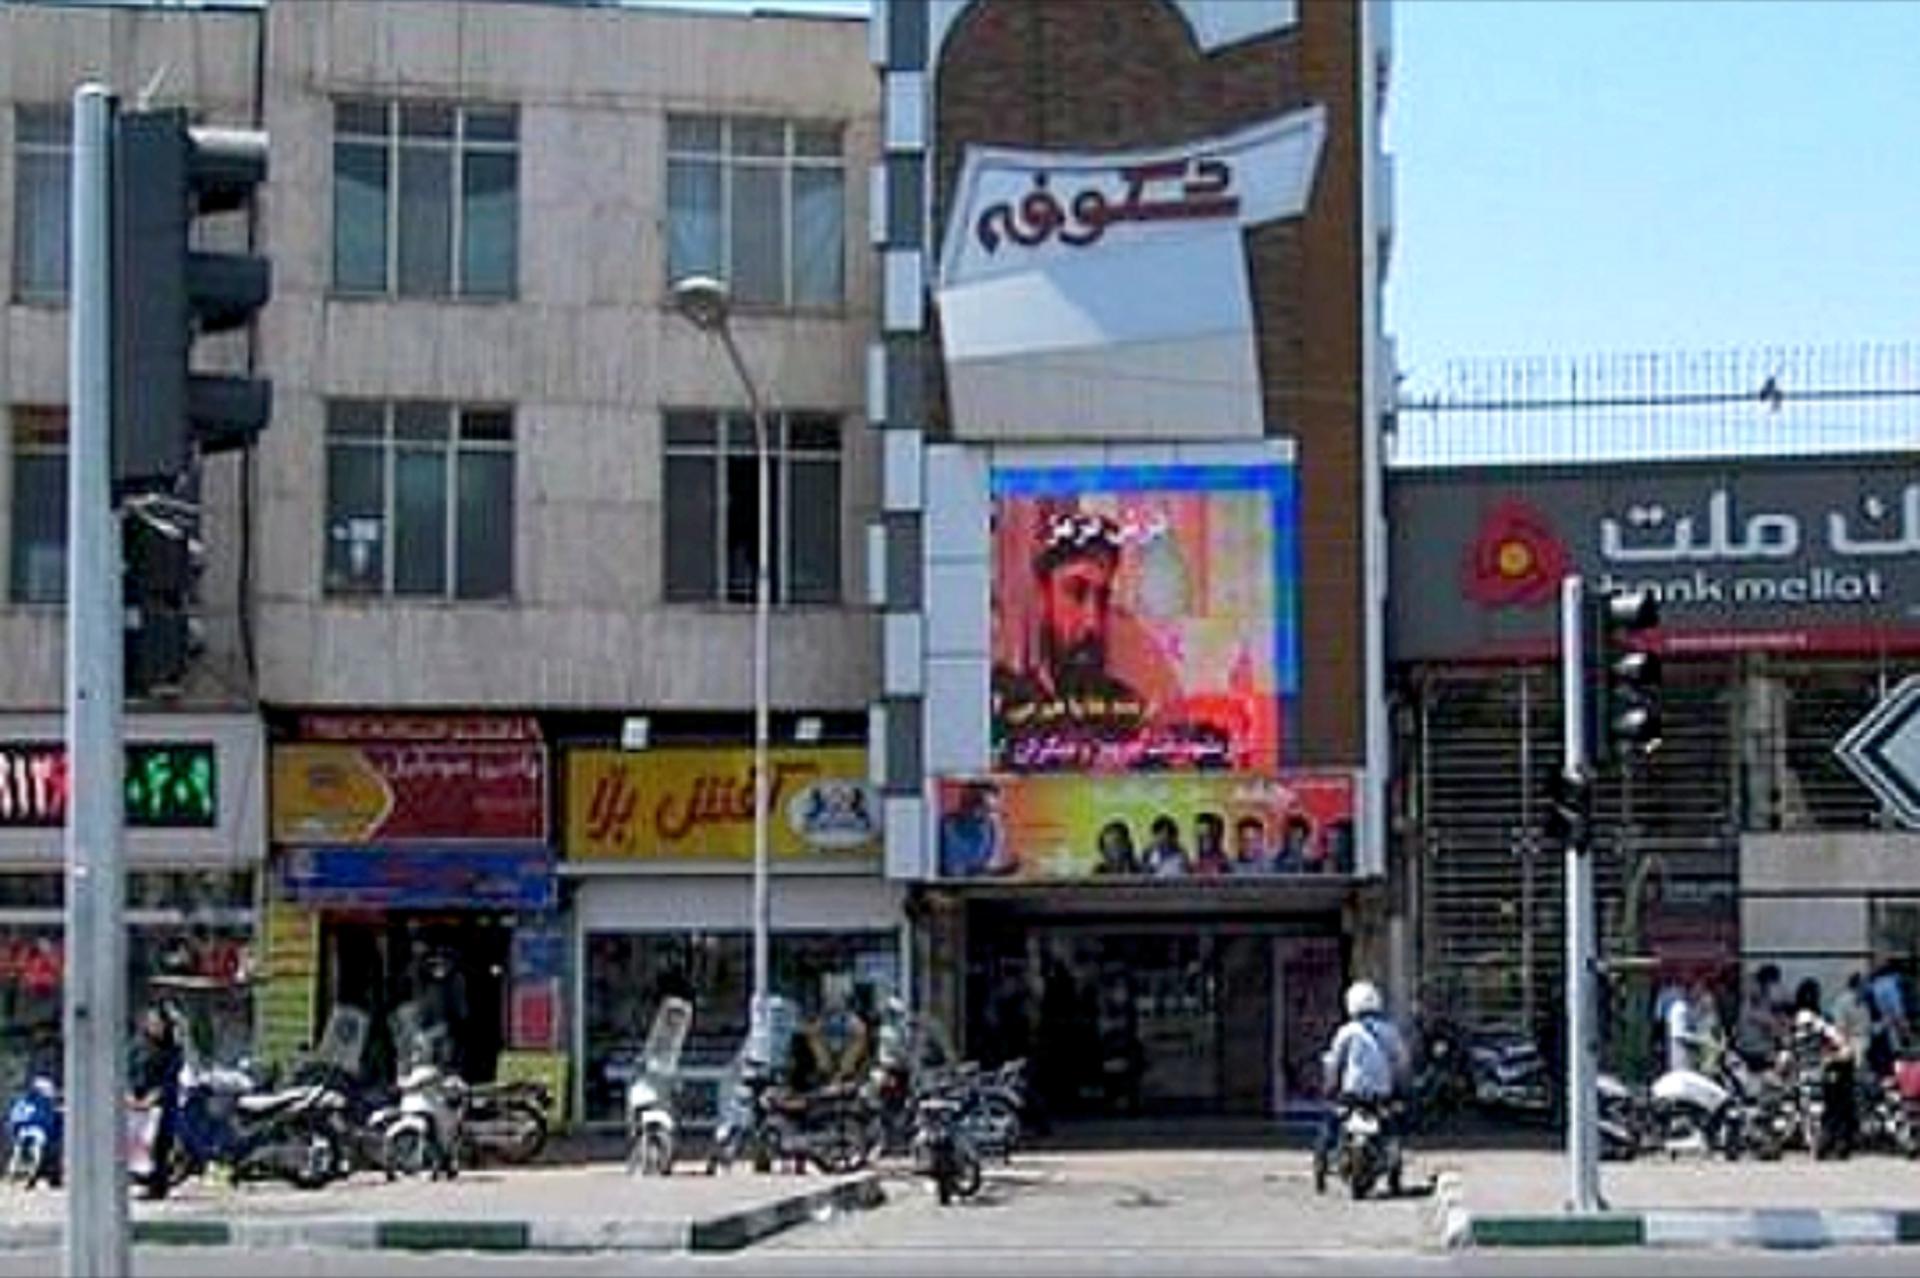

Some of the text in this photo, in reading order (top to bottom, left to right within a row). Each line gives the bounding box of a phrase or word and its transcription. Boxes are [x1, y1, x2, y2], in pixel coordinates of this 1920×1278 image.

[976, 151, 1241, 255] شکوفه
[1600, 489, 1801, 561] ملت
[1600, 566, 1883, 602] bank mellat
